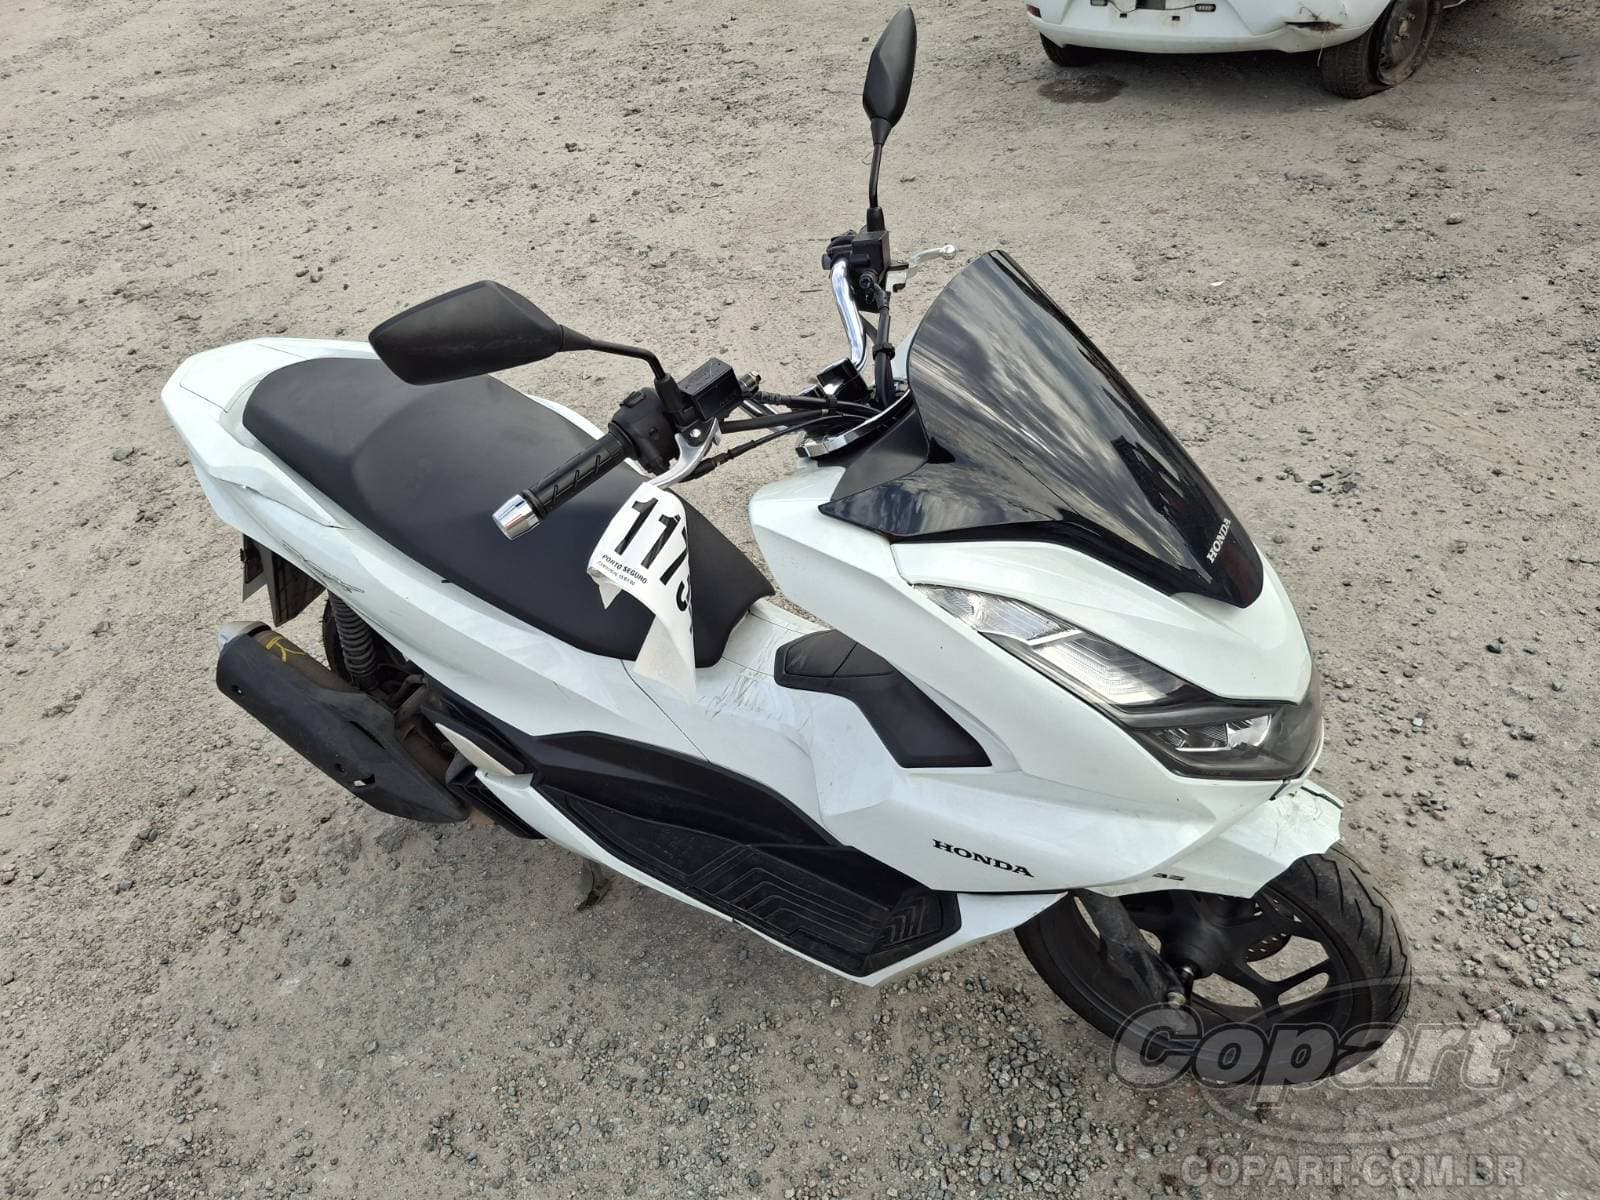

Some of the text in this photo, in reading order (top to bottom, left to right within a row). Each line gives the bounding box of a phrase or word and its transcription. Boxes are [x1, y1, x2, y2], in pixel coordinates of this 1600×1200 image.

[1206, 518, 1231, 564] HONDA
[601, 554, 623, 570] PORTO
[622, 566, 648, 584] SEGURO
[932, 838, 1035, 878] HONDA
